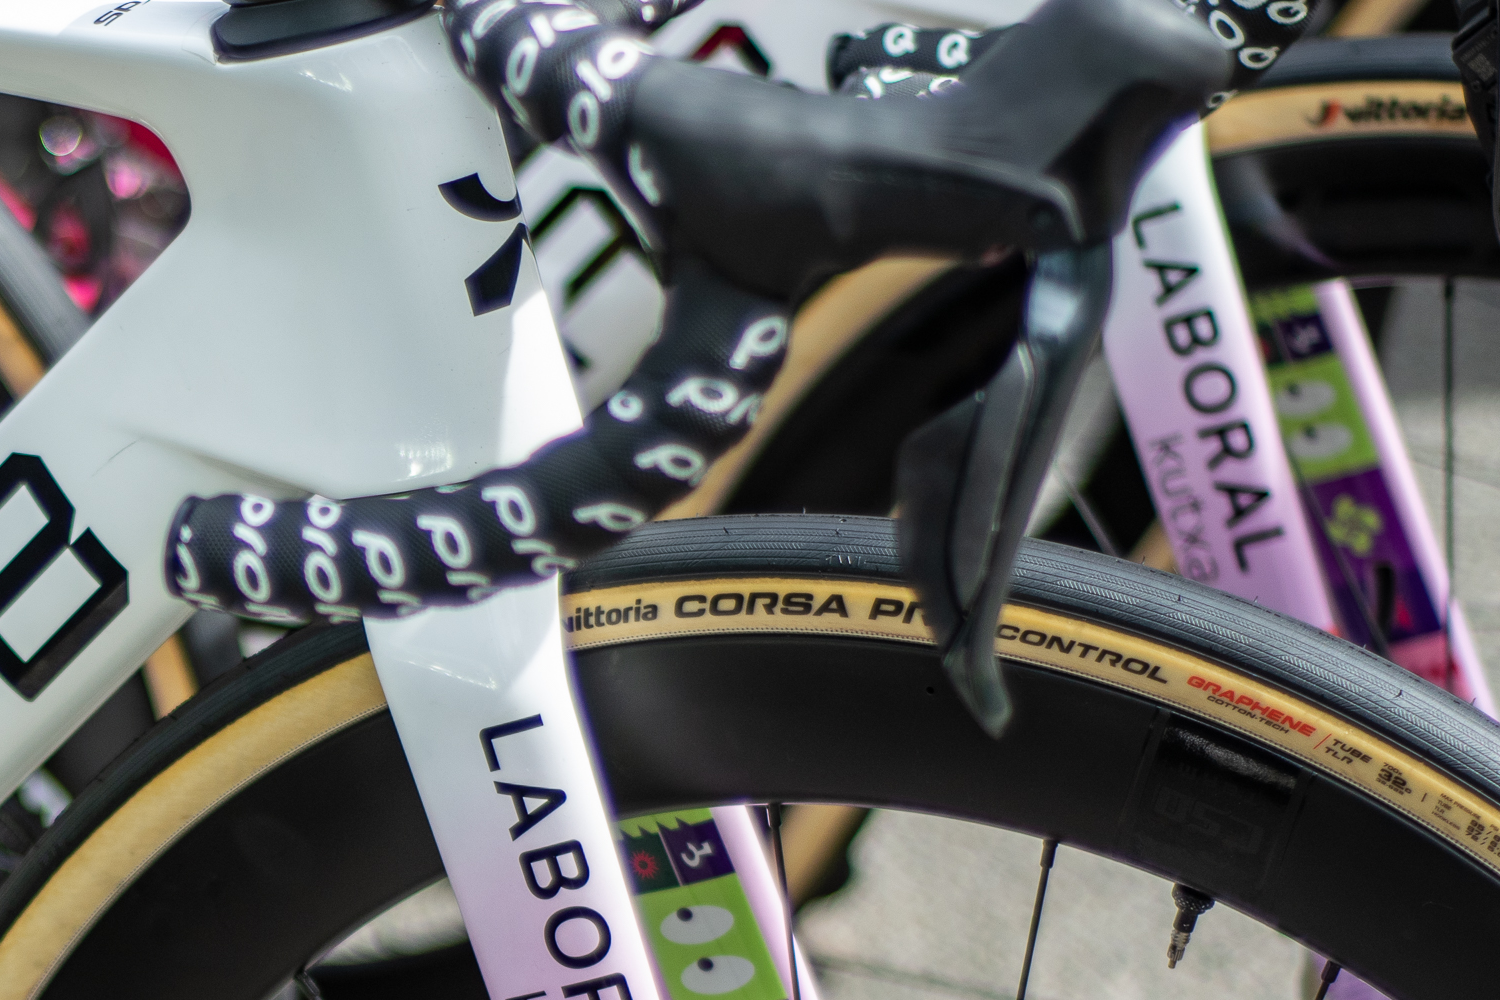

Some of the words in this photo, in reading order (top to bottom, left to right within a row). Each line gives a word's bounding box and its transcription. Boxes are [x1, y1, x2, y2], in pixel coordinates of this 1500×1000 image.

[1132, 203, 1284, 573] LABORAL
[674, 591, 849, 619] CORSA
[996, 623, 1168, 684] CONTROL
[1186, 675, 1316, 737] GRAPHENE
[1324, 746, 1355, 765] TLR
[1332, 738, 1373, 763] TUBE
